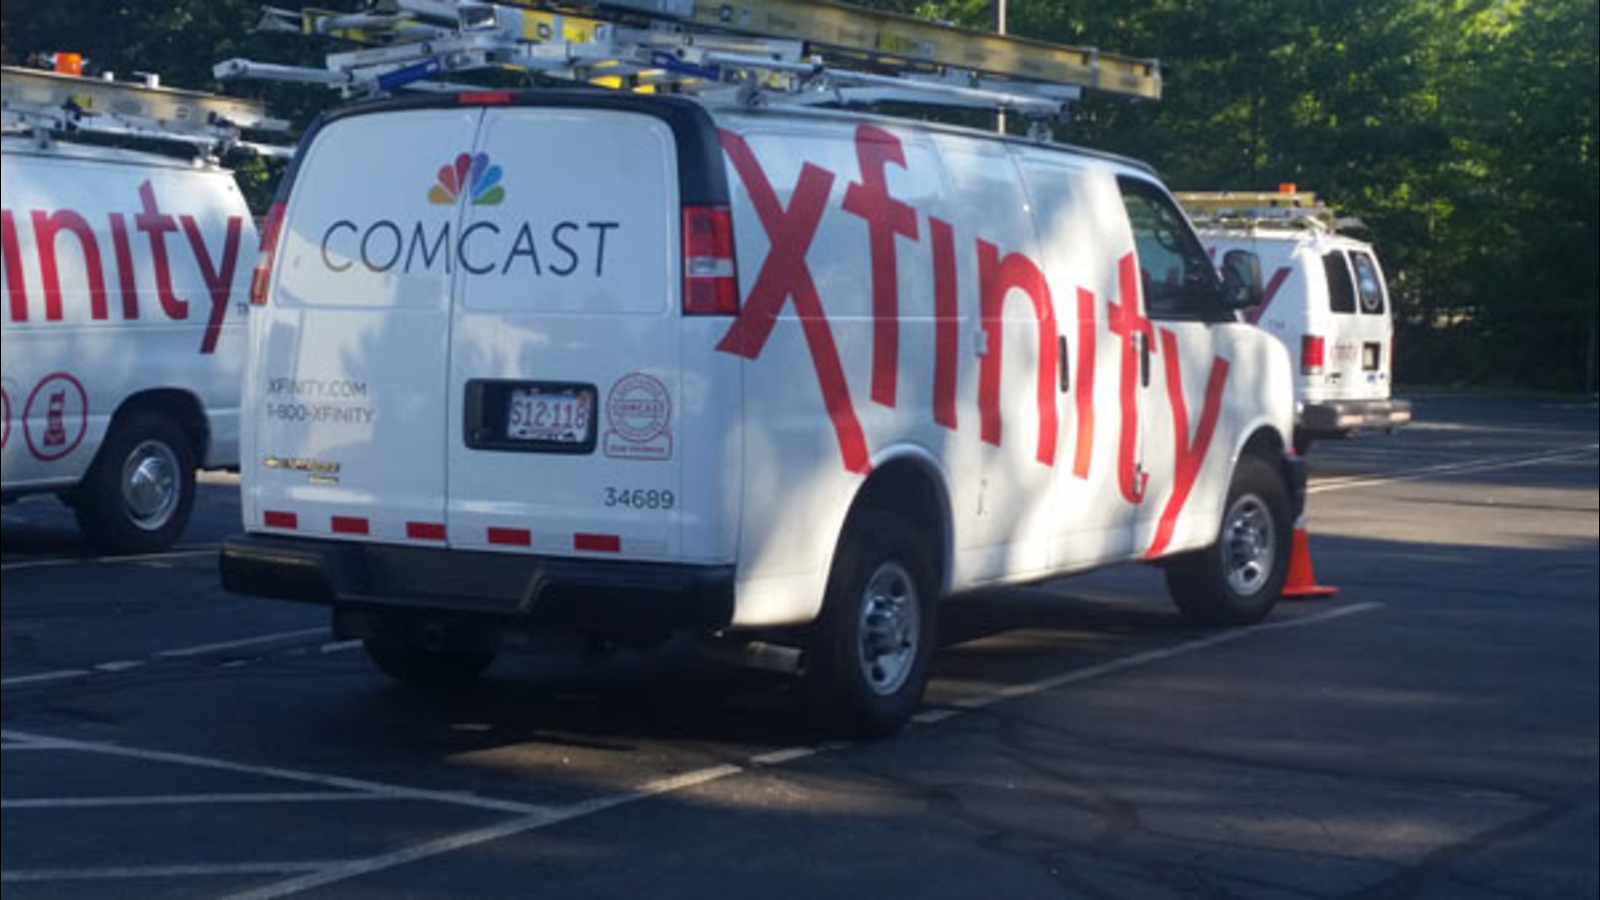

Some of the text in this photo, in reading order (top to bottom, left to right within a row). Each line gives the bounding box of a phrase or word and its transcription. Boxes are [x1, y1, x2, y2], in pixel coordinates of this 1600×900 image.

[321, 219, 620, 277] COMCAST
[716, 124, 1229, 557] xfinity
[267, 377, 367, 397] XFINITY.COM
[267, 402, 374, 423] 1-800-XFINITY
[603, 486, 675, 509] 34689
